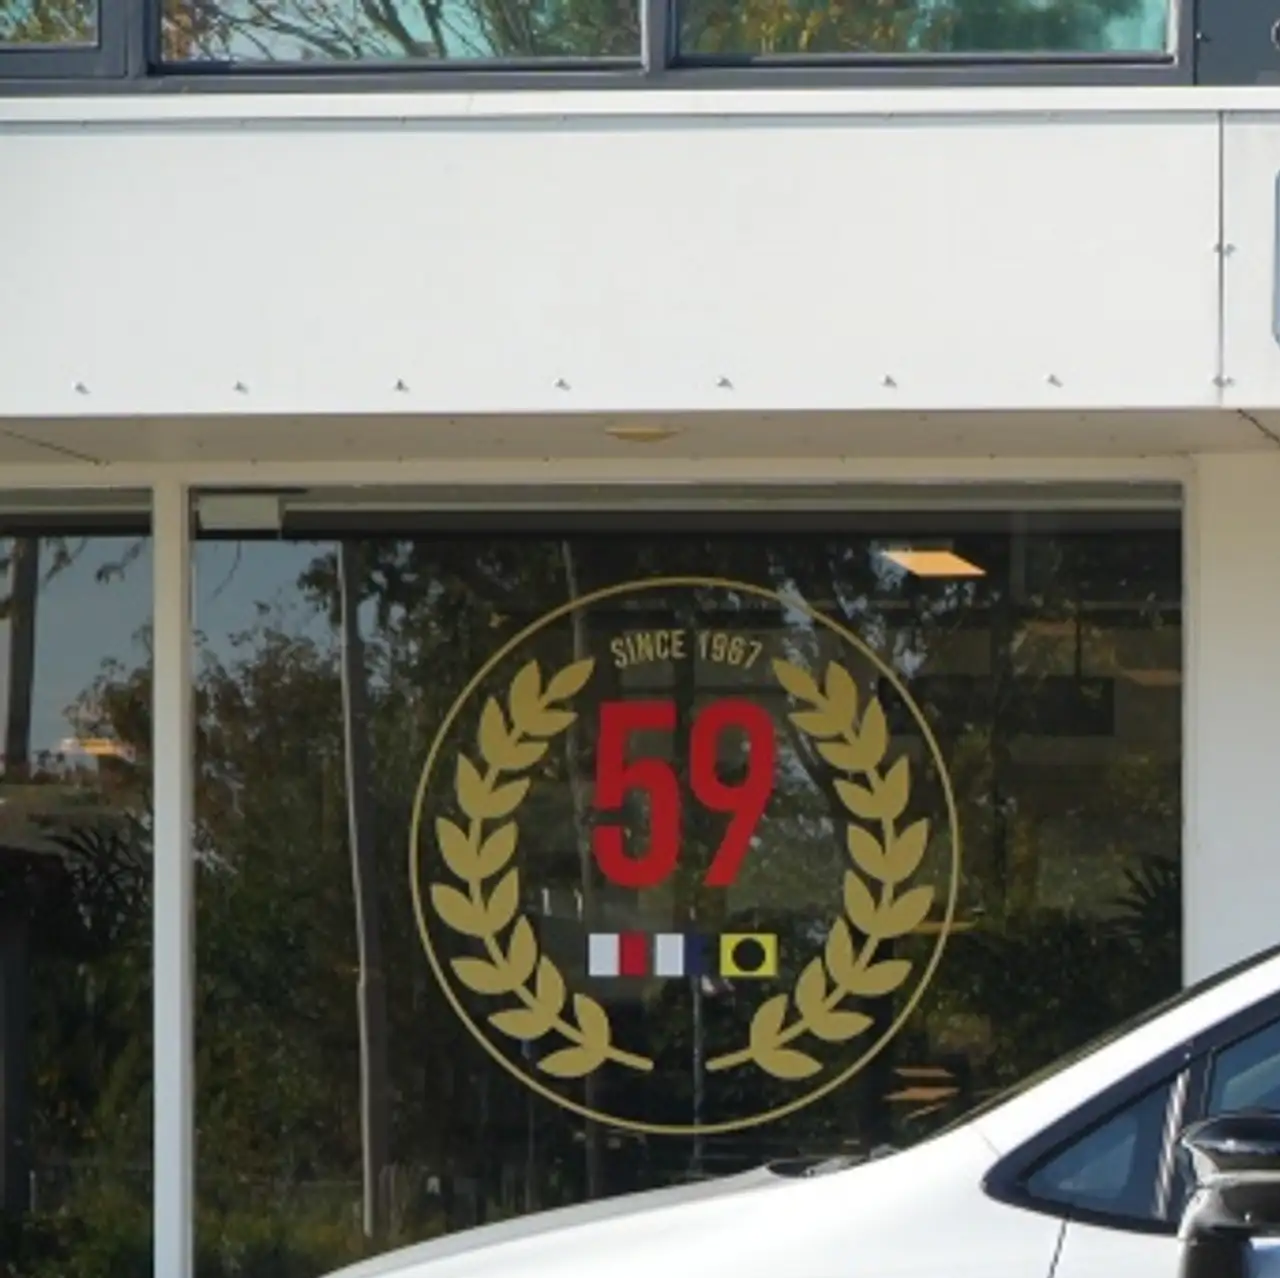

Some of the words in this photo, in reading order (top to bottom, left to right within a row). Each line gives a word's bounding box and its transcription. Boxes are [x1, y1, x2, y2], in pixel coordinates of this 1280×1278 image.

[611, 630, 687, 669] SINCE
[699, 629, 763, 669] 1967
[592, 698, 777, 888] 59
